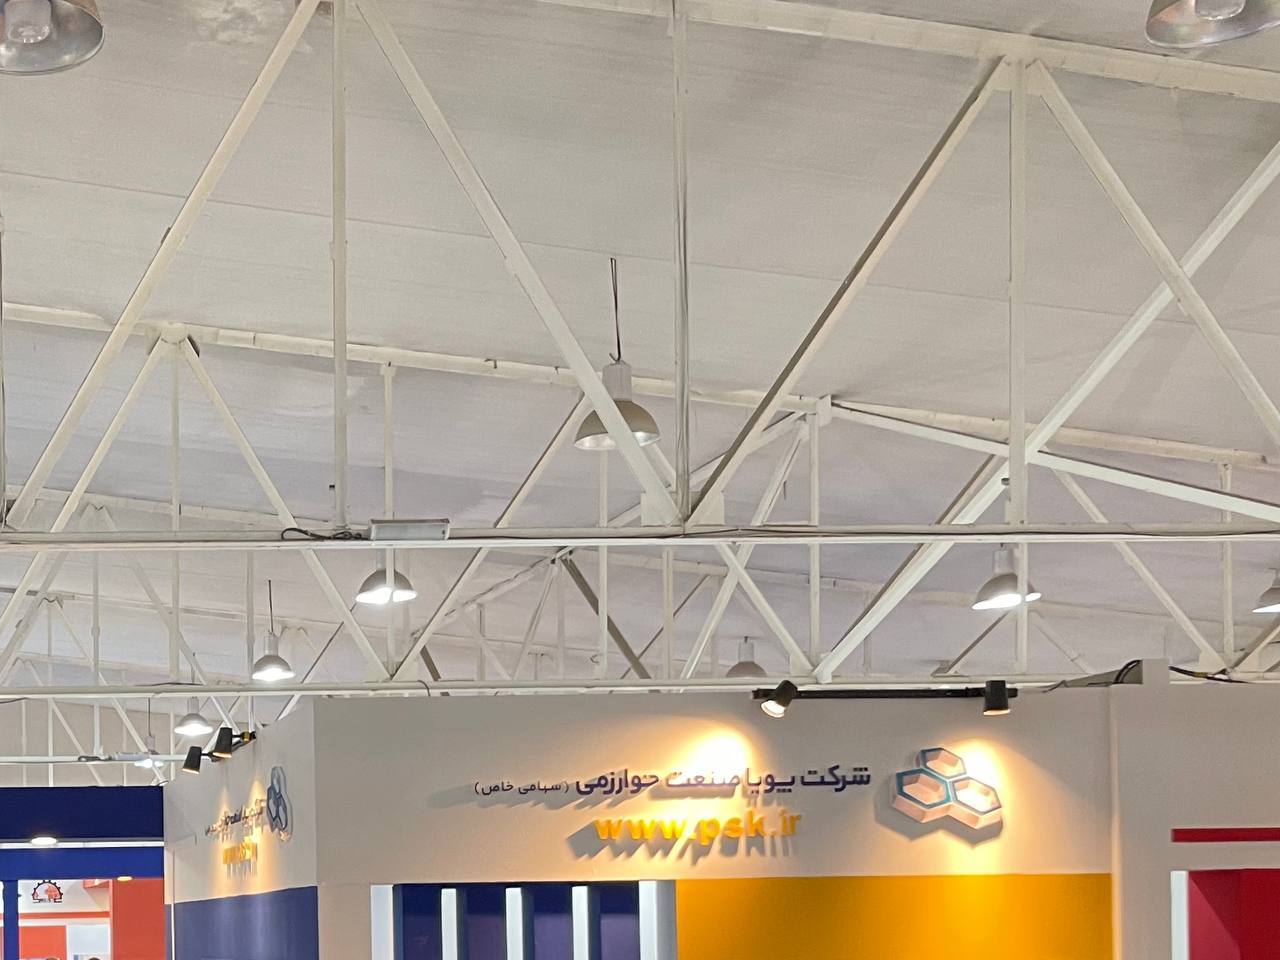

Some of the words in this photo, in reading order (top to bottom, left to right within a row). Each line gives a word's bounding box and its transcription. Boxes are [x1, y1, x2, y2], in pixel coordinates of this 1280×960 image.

[665, 769, 741, 788] صنعت
[746, 767, 795, 794] پویا
[799, 764, 871, 793] شرکت
[593, 807, 802, 846] www.psk.ir
